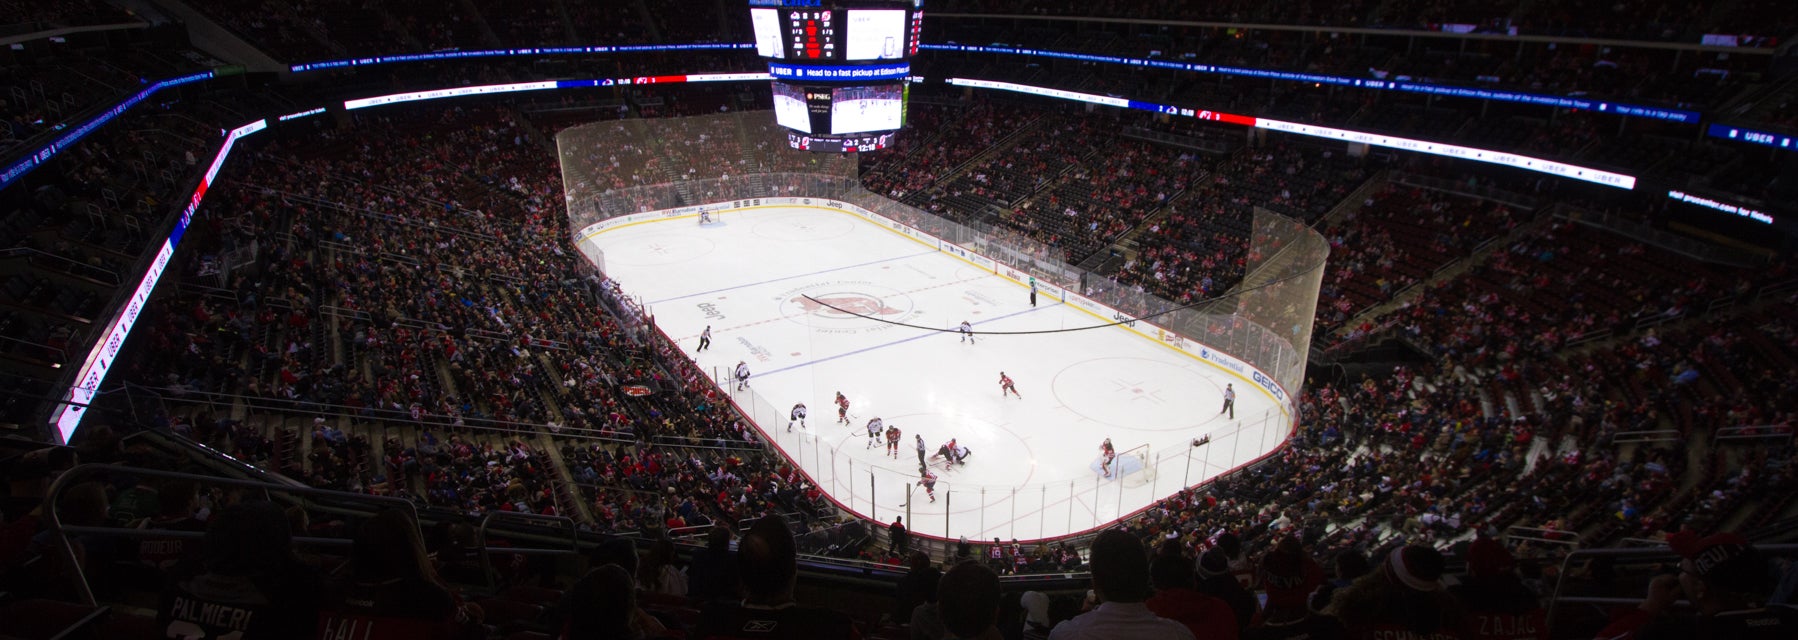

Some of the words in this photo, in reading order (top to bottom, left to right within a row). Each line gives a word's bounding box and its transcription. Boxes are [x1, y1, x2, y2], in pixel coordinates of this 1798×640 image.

[776, 67, 792, 76] UBER
[852, 69, 873, 77] pickup
[880, 68, 896, 76] Edison
[1744, 131, 1775, 144] UBER
[858, 143, 876, 152] 12:18
[1493, 155, 1517, 164] UBER
[1541, 163, 1566, 172] UBER
[1594, 173, 1620, 183] UBER
[826, 199, 843, 209] Jeep
[1668, 189, 1684, 200] visit
[1683, 193, 1738, 214] prucenter.com
[1737, 207, 1749, 217] for
[1750, 210, 1773, 223] tickets
[1113, 311, 1136, 328] Jeep
[108, 333, 121, 358] UBER
[1211, 354, 1244, 373] Prudential
[84, 371, 99, 401] UBER
[1252, 371, 1284, 401] GEICO
[991, 551, 1003, 559] 19
[171, 596, 254, 632] PALMIERI
